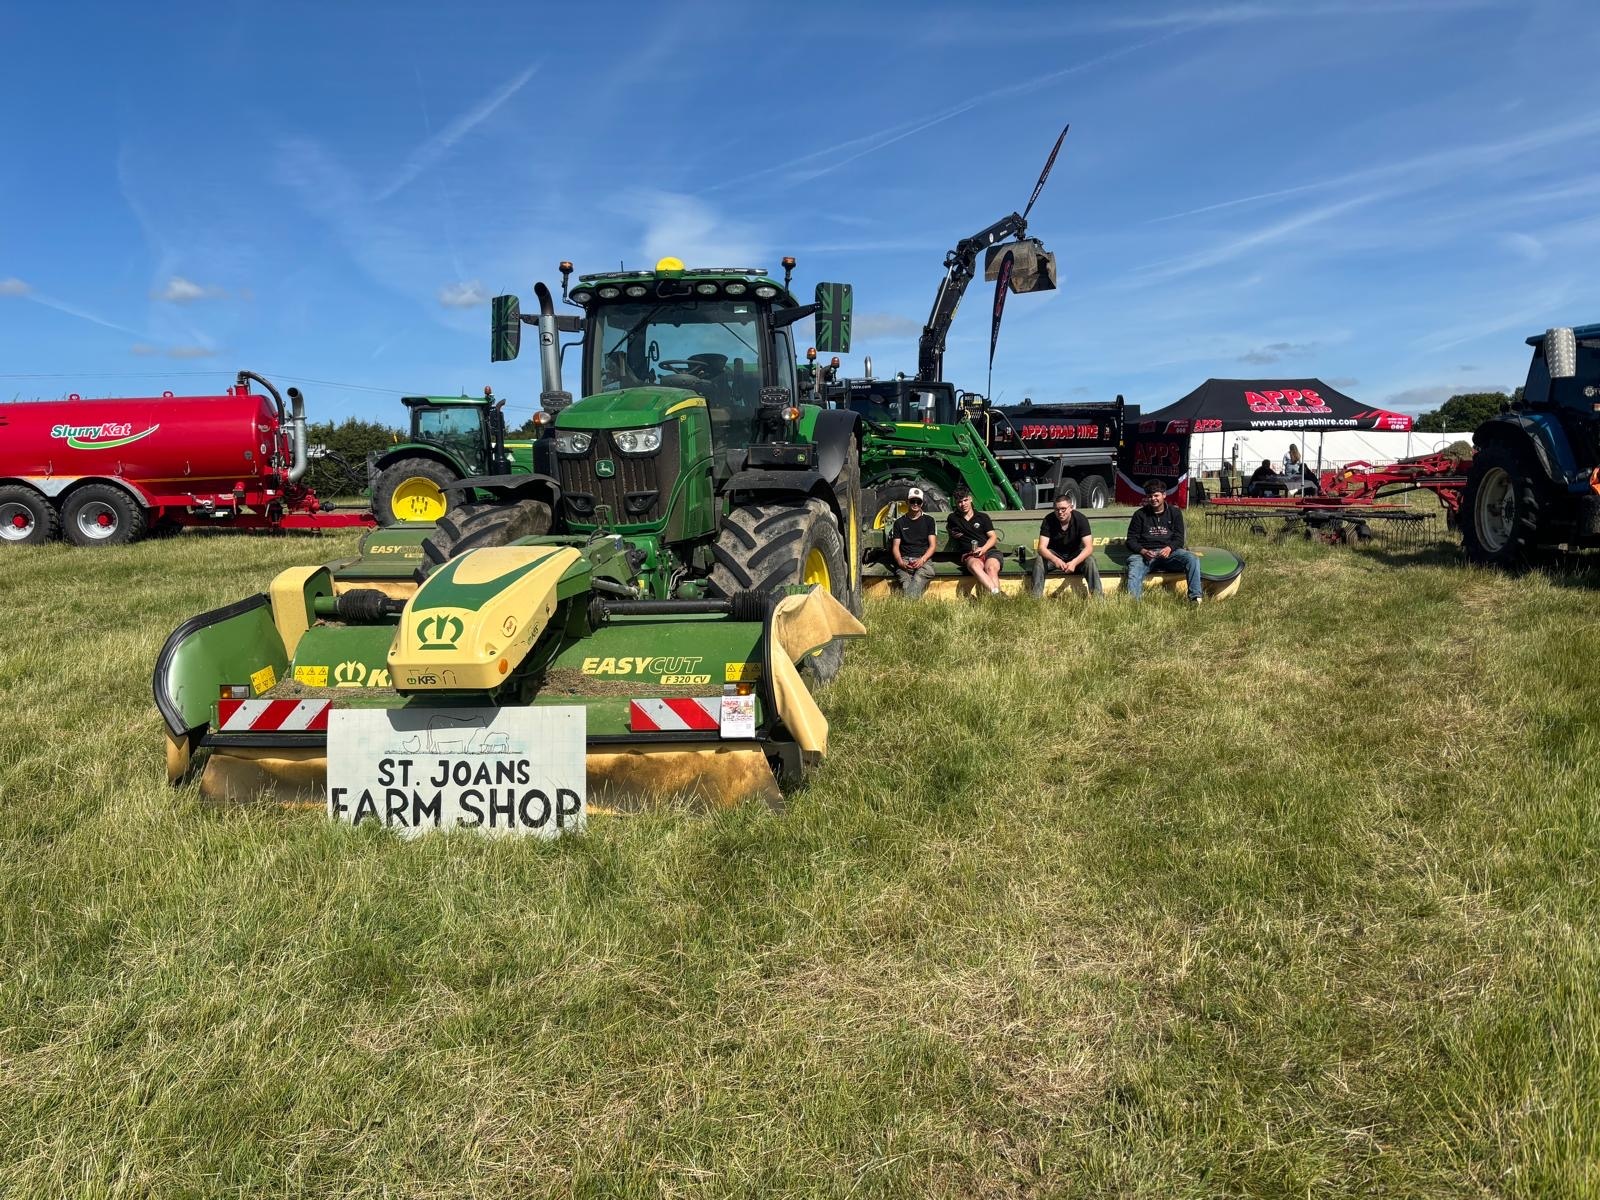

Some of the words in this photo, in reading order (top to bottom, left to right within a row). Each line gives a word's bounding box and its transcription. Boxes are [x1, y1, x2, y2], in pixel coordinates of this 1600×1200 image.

[1244, 389, 1325, 407] APPS
[51, 423, 131, 440] SlurryKat
[1195, 419, 1223, 429] APPS
[1250, 418, 1358, 428] www.appsgrabhire.com
[1020, 424, 1048, 440] APPS
[1049, 424, 1075, 440] GRAB
[1077, 424, 1098, 439] HIRE
[1134, 441, 1181, 466] APPS
[581, 656, 703, 675] EASYCUT
[418, 675, 437, 685] KFS
[665, 675, 673, 684] F
[673, 675, 691, 684] 320
[693, 675, 707, 684] CV
[377, 758, 420, 788] ST.
[430, 759, 531, 788] JOANS
[331, 787, 442, 828] FARM
[456, 788, 582, 829] SHOP
